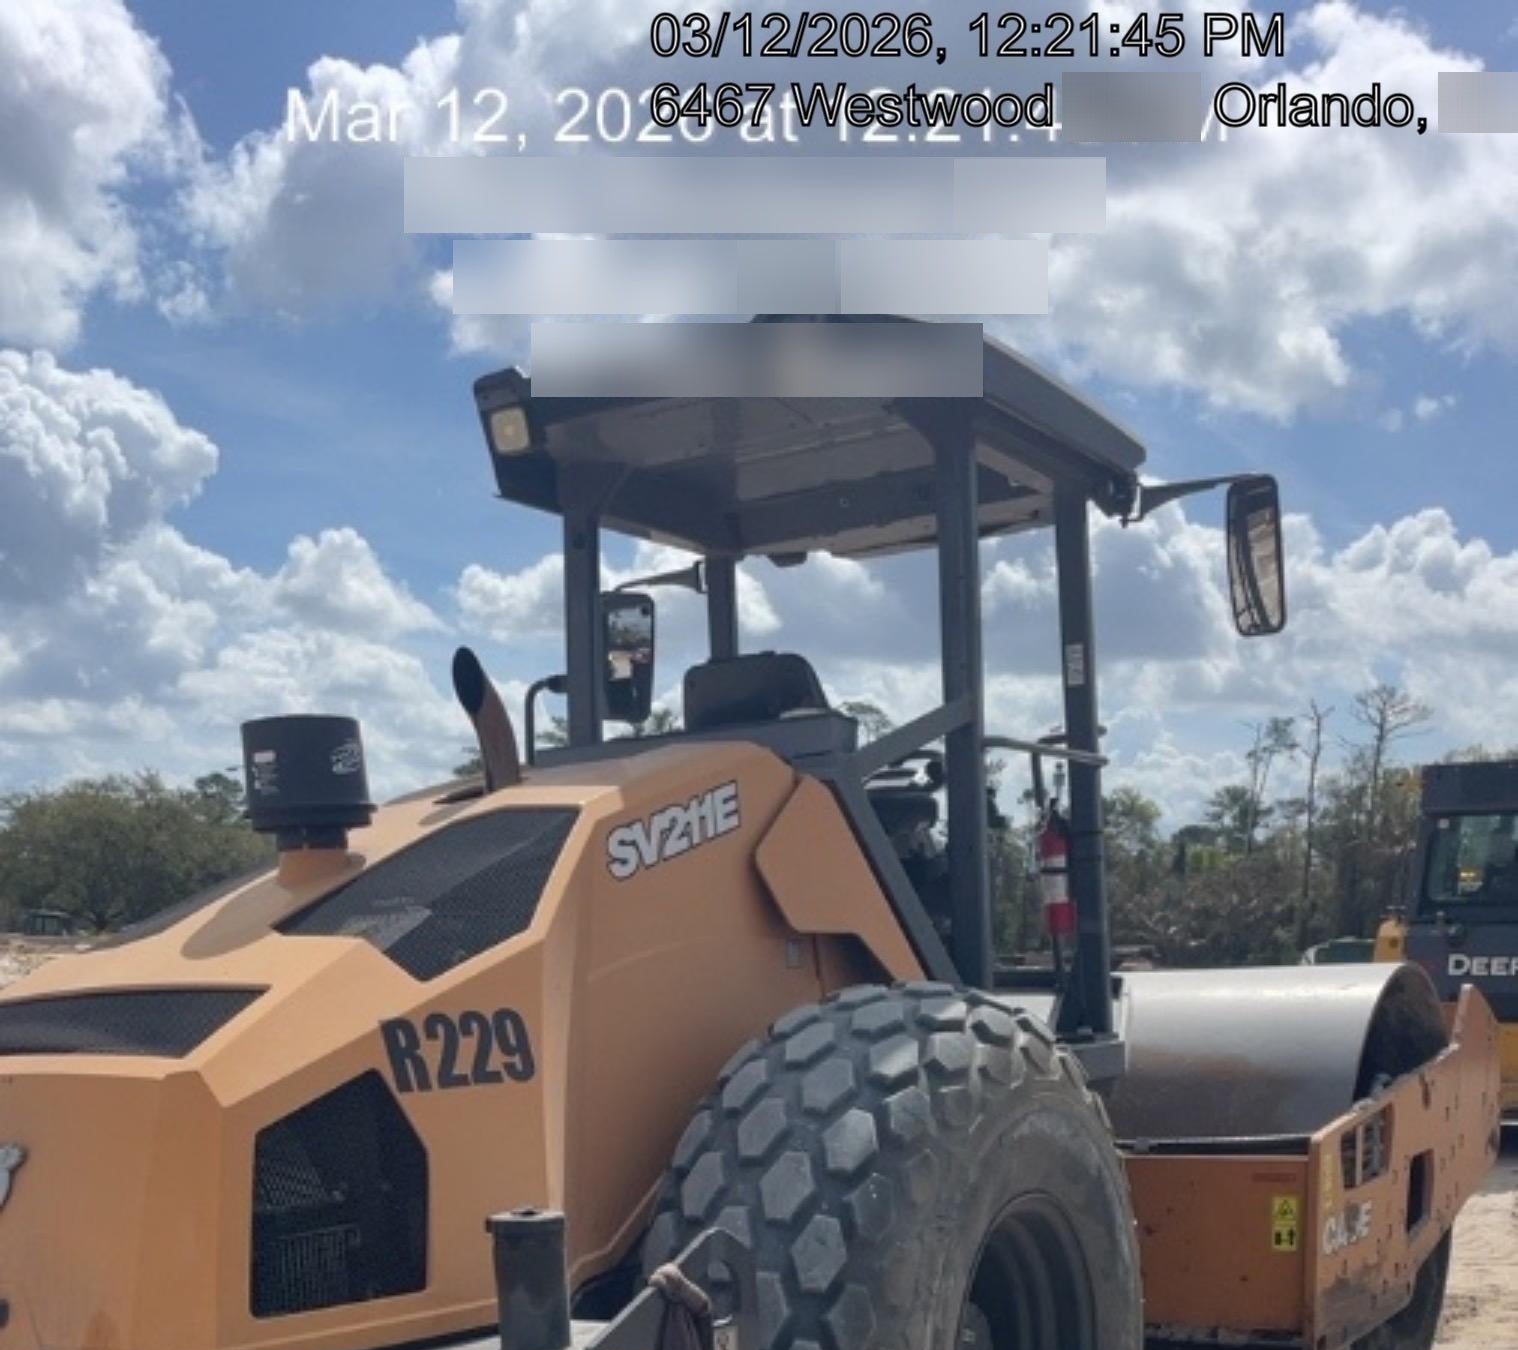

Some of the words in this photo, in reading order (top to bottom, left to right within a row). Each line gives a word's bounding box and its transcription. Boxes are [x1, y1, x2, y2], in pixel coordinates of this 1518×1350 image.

[607, 780, 741, 881] SV211E
[380, 1008, 535, 1093] R229
[1322, 1200, 1372, 1255] CAE
